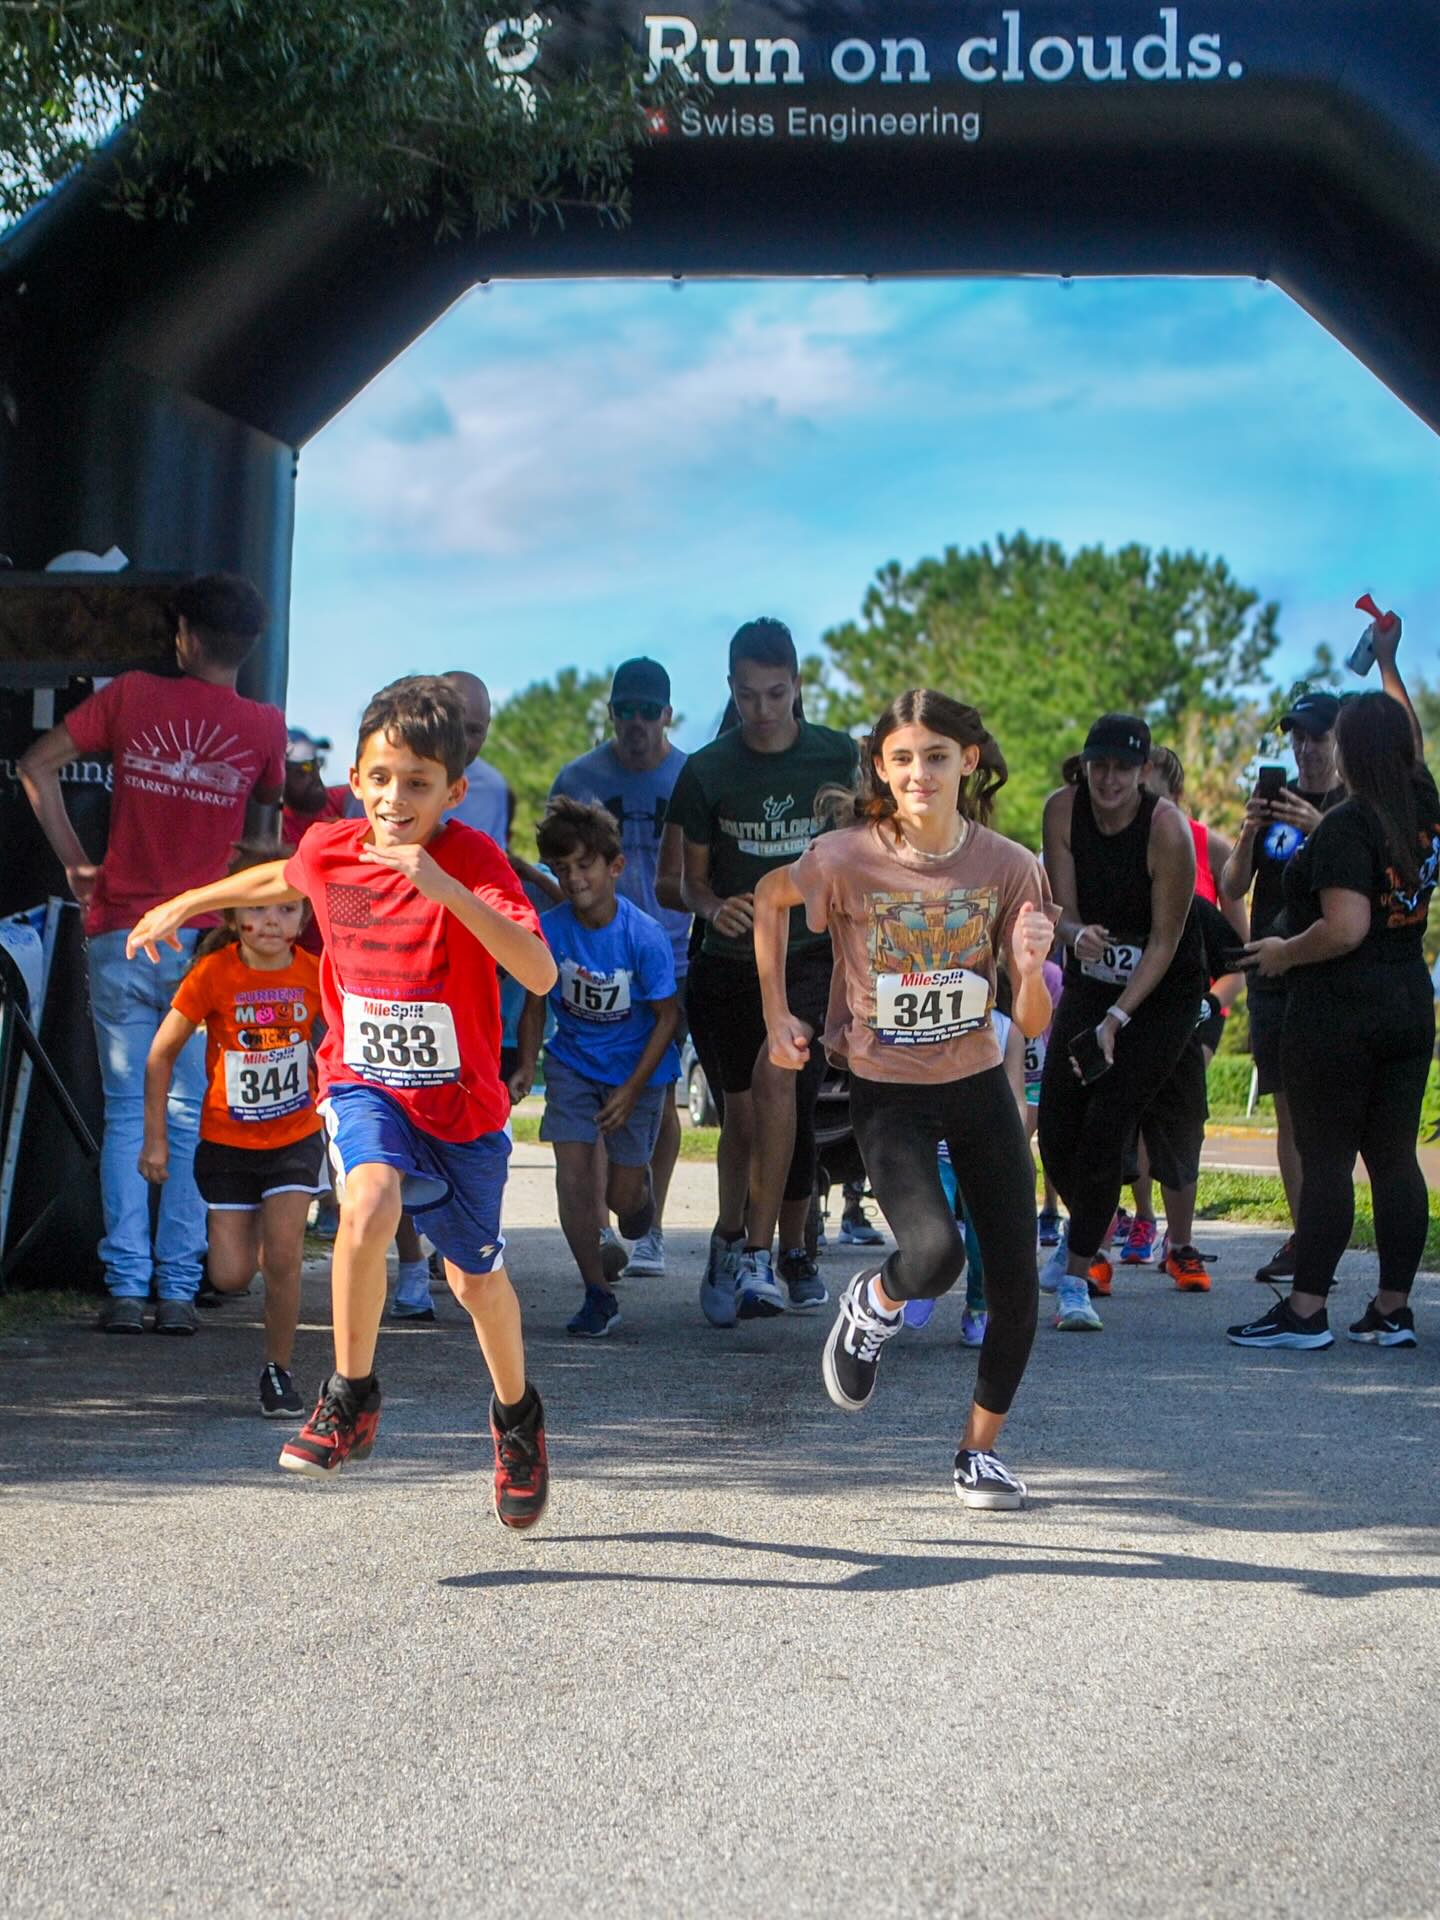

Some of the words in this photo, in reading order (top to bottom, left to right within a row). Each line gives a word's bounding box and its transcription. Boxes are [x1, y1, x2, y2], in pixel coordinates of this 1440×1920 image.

[643, 15, 804, 84] Run
[831, 37, 930, 84] on
[957, 8, 1244, 83] clouds.
[681, 107, 774, 137] Swiss
[788, 106, 981, 142] Engineering
[123, 774, 179, 797] STARKEY
[182, 787, 238, 808] MARKET
[719, 817, 766, 840] SOUTH
[235, 988, 305, 1004] CURRENT
[572, 979, 620, 1011] 157
[893, 990, 964, 1028] 341
[360, 1021, 439, 1068] 333
[239, 1062, 300, 1104] 344
